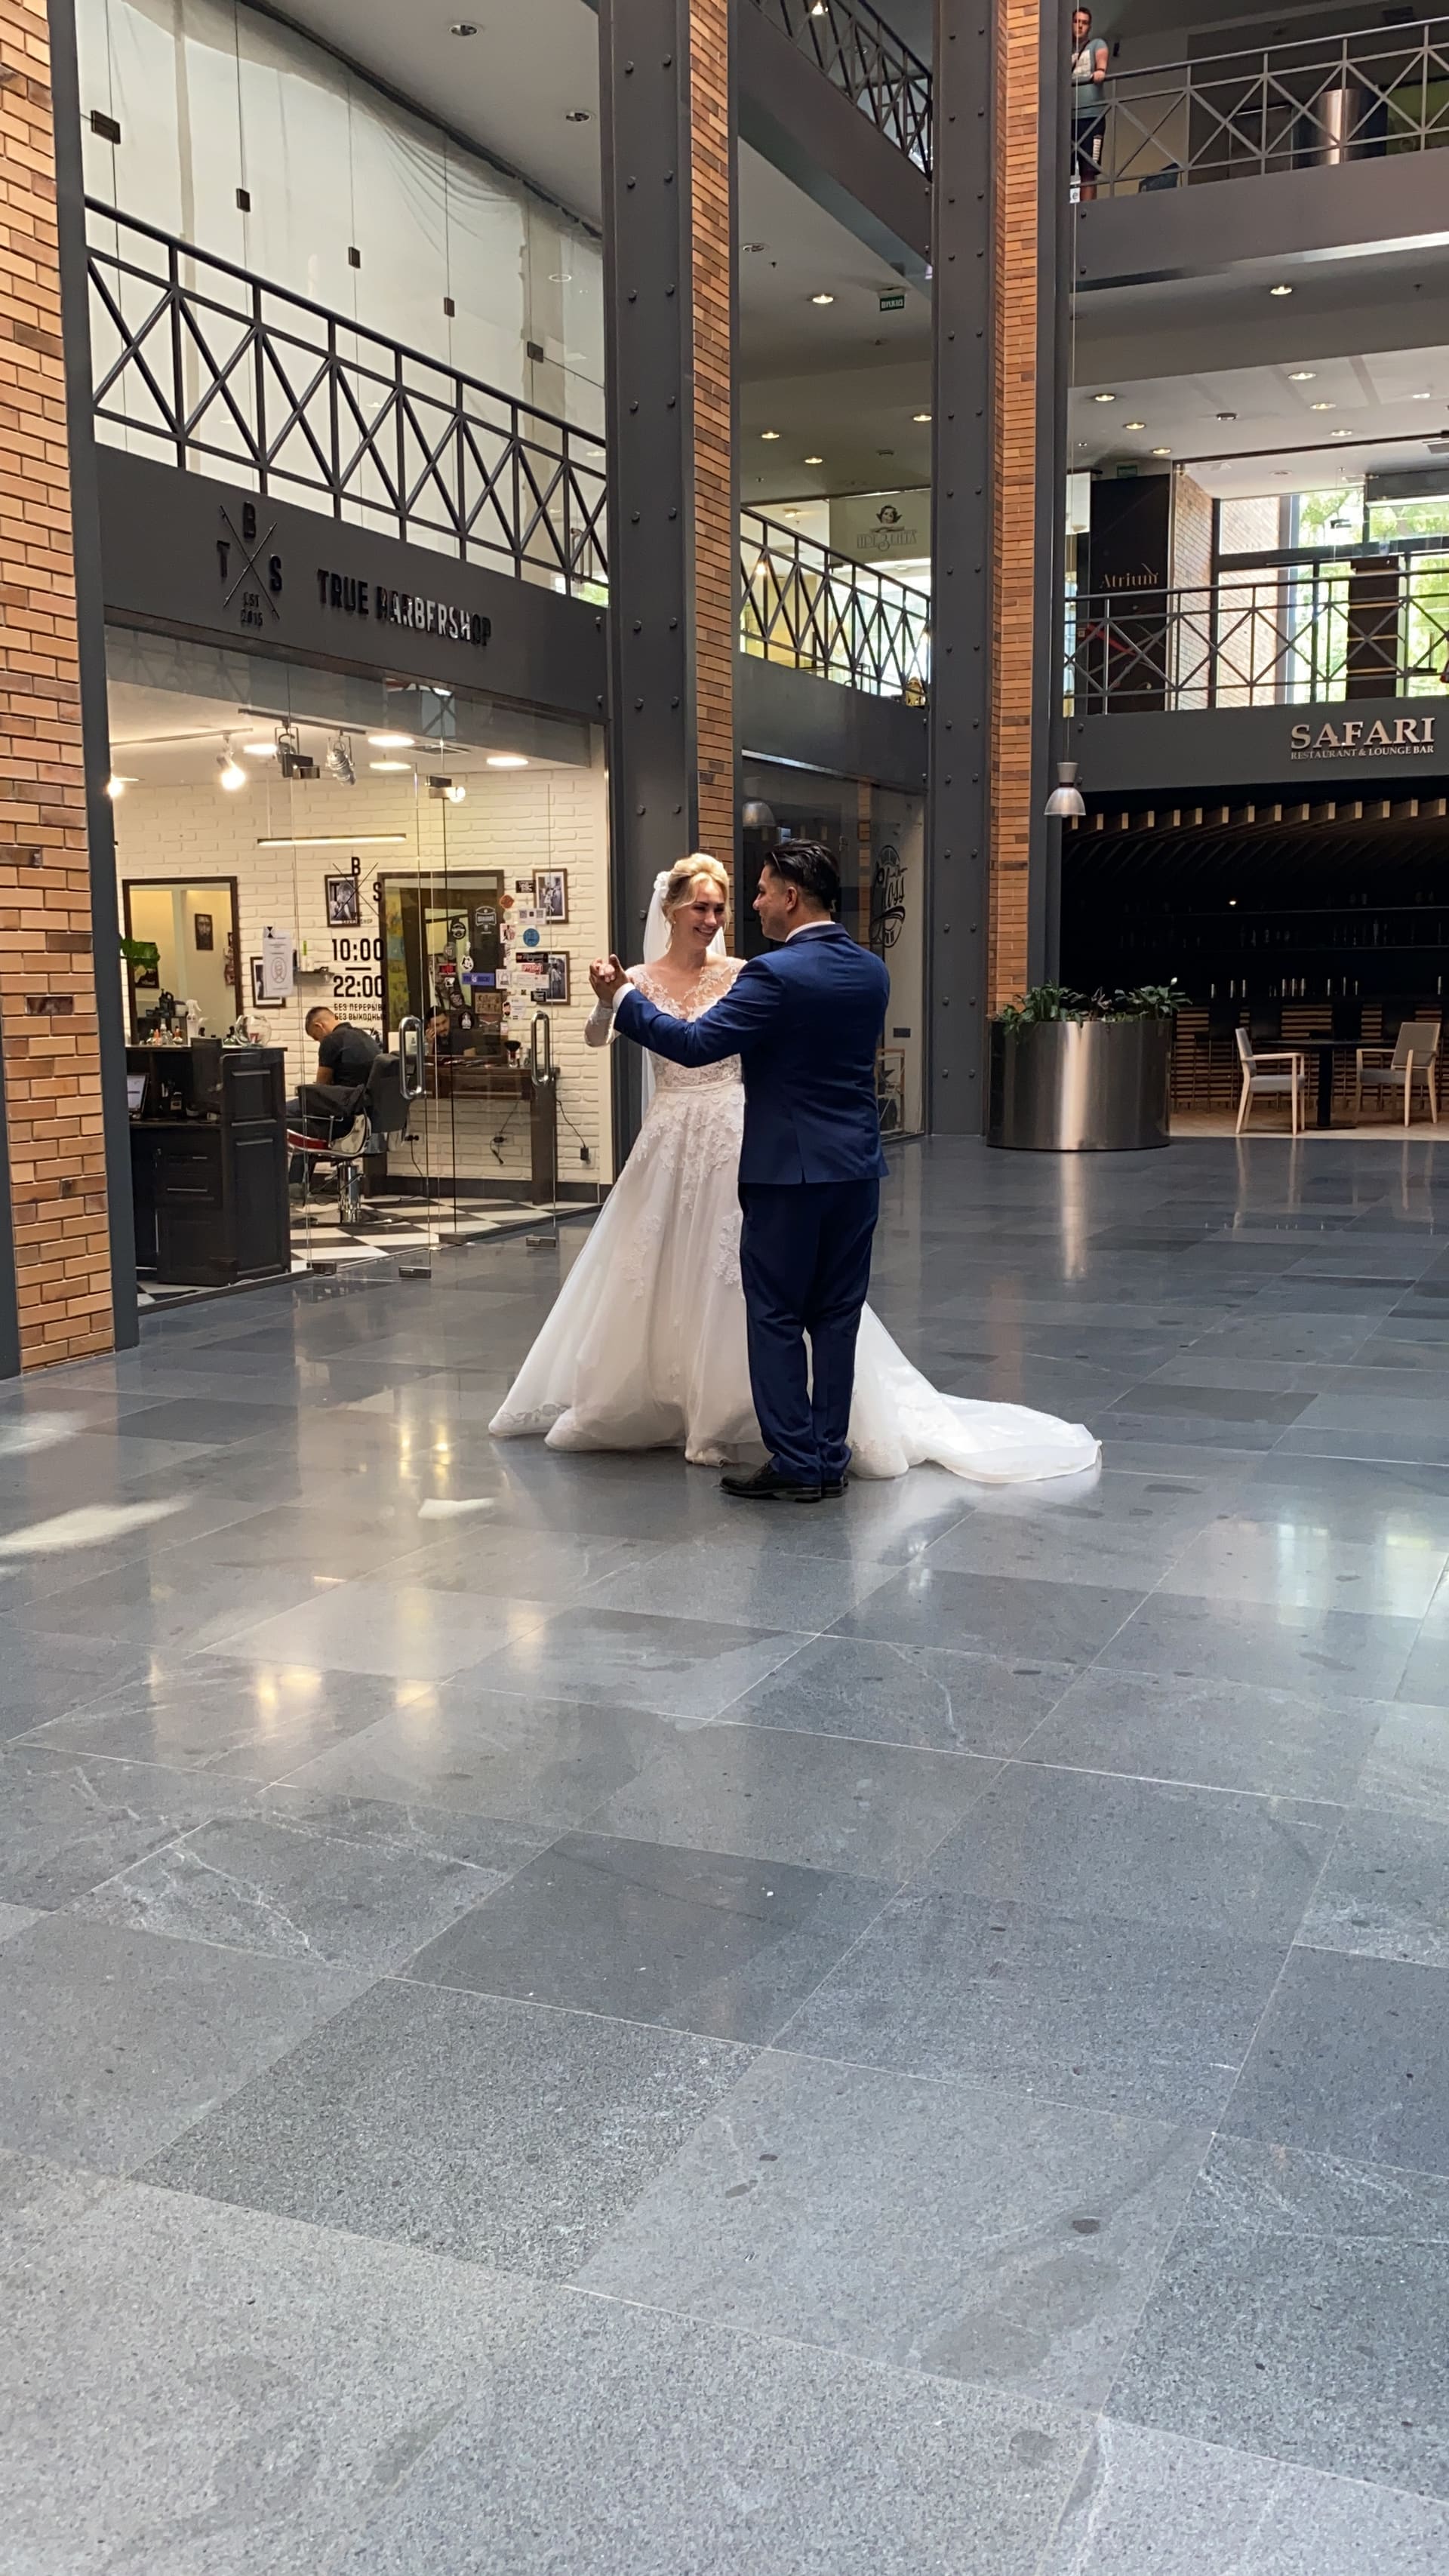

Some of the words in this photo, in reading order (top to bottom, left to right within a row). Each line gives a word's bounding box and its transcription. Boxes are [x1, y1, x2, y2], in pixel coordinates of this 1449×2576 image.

[242, 501, 257, 539] B
[217, 540, 230, 580] T
[269, 554, 282, 592] S
[243, 591, 260, 608] EST
[317, 568, 369, 615] TRUE
[376, 585, 491, 648] BARBERSHOP
[1291, 717, 1435, 749] SAFARI
[1291, 748, 1357, 760] RESTAURANT
[1358, 748, 1367, 756] &
[1368, 746, 1411, 756] LOUNGE
[1413, 744, 1435, 754] BAR
[351, 857, 361, 876] B
[373, 882, 382, 901] S
[332, 938, 384, 961] 10:00
[334, 975, 386, 998] 22:00
[334, 1003, 347, 1011] БЕЗ
[349, 1013, 386, 1021] ВЫХОДНЫ
